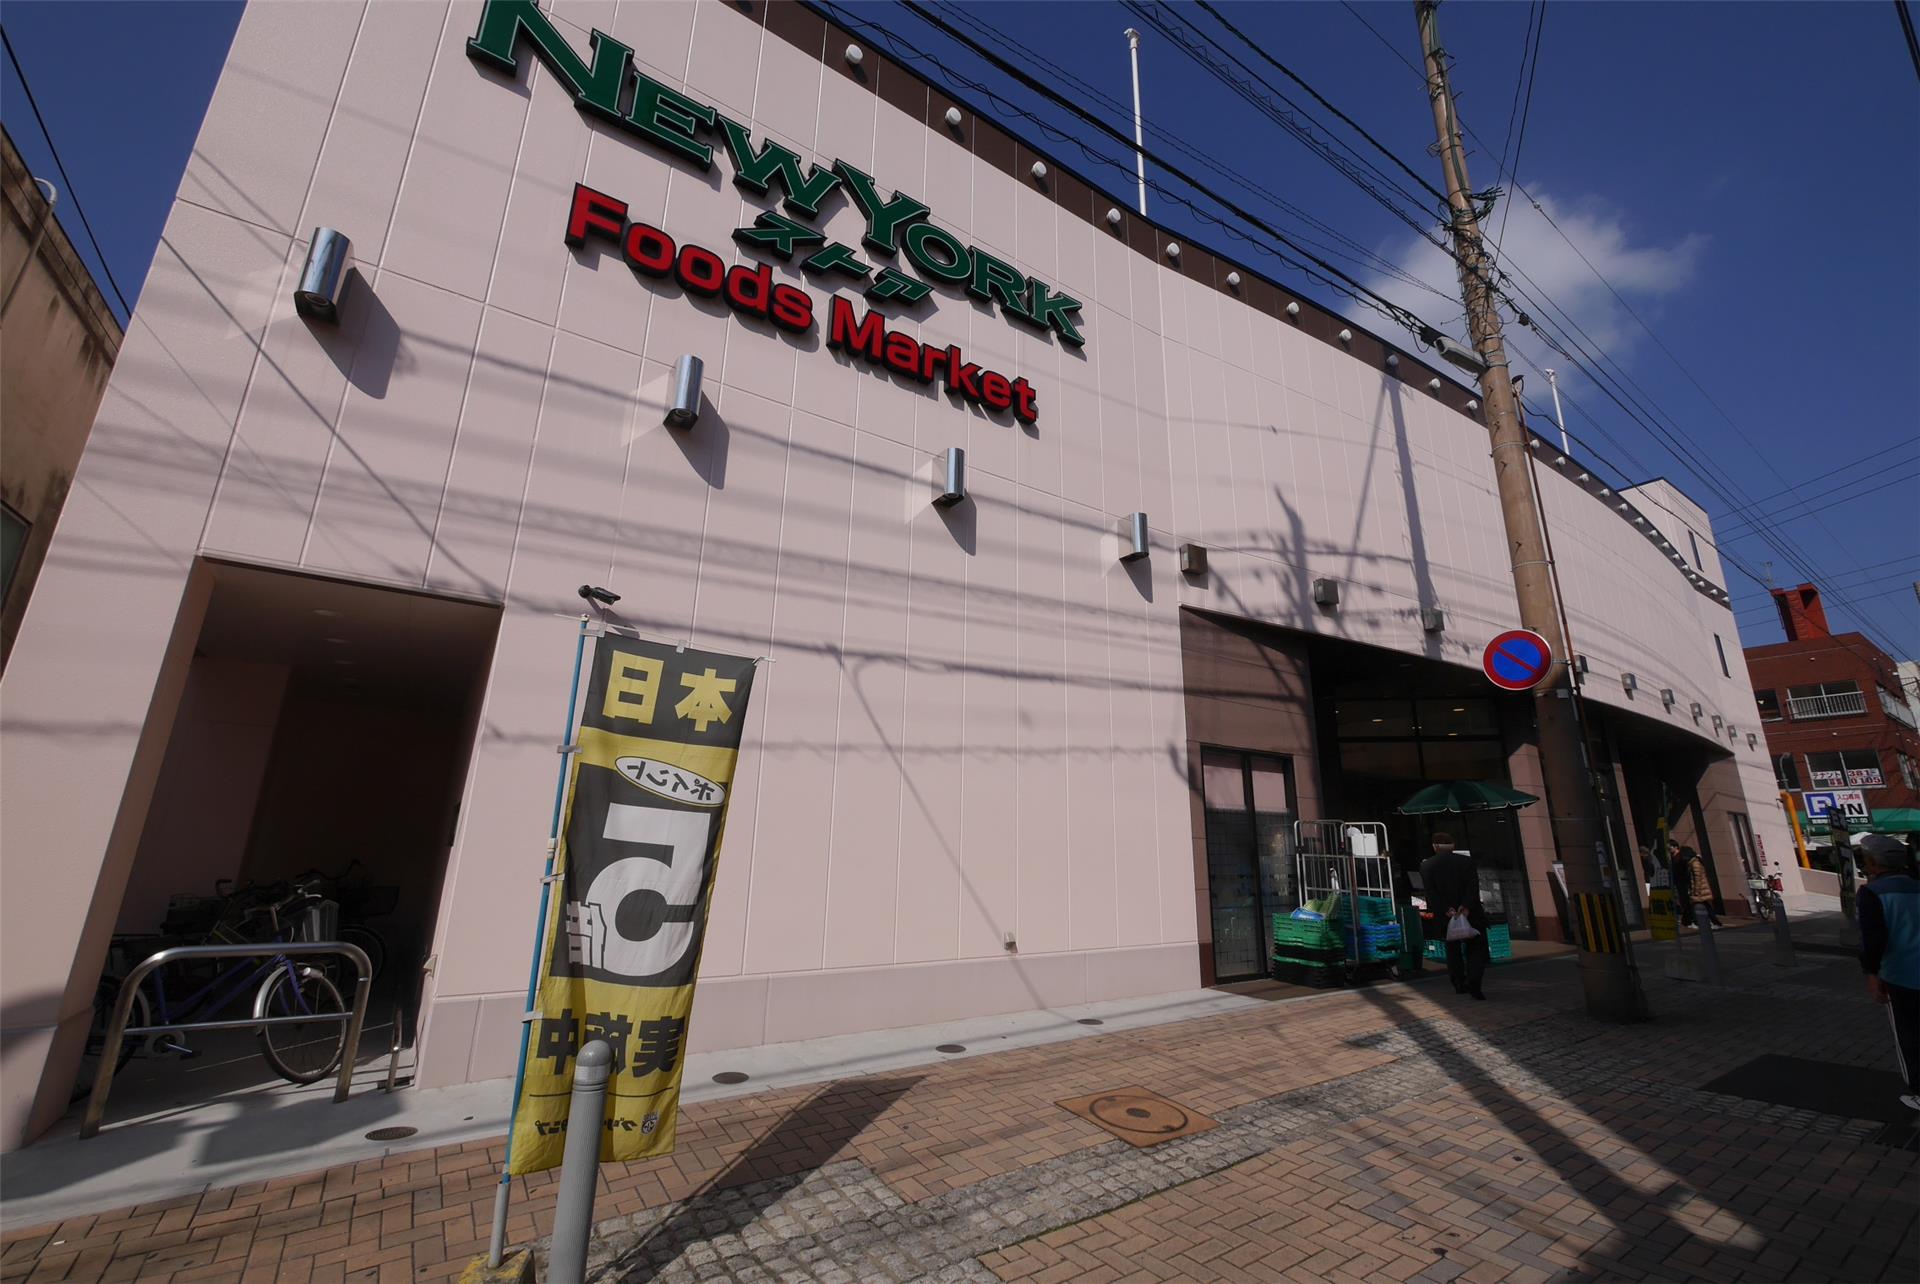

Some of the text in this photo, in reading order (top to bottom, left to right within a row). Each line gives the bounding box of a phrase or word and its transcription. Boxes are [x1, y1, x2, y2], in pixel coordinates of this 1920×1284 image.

[565, 183, 1039, 424] Foods Market
[733, 210, 933, 304] ストア
